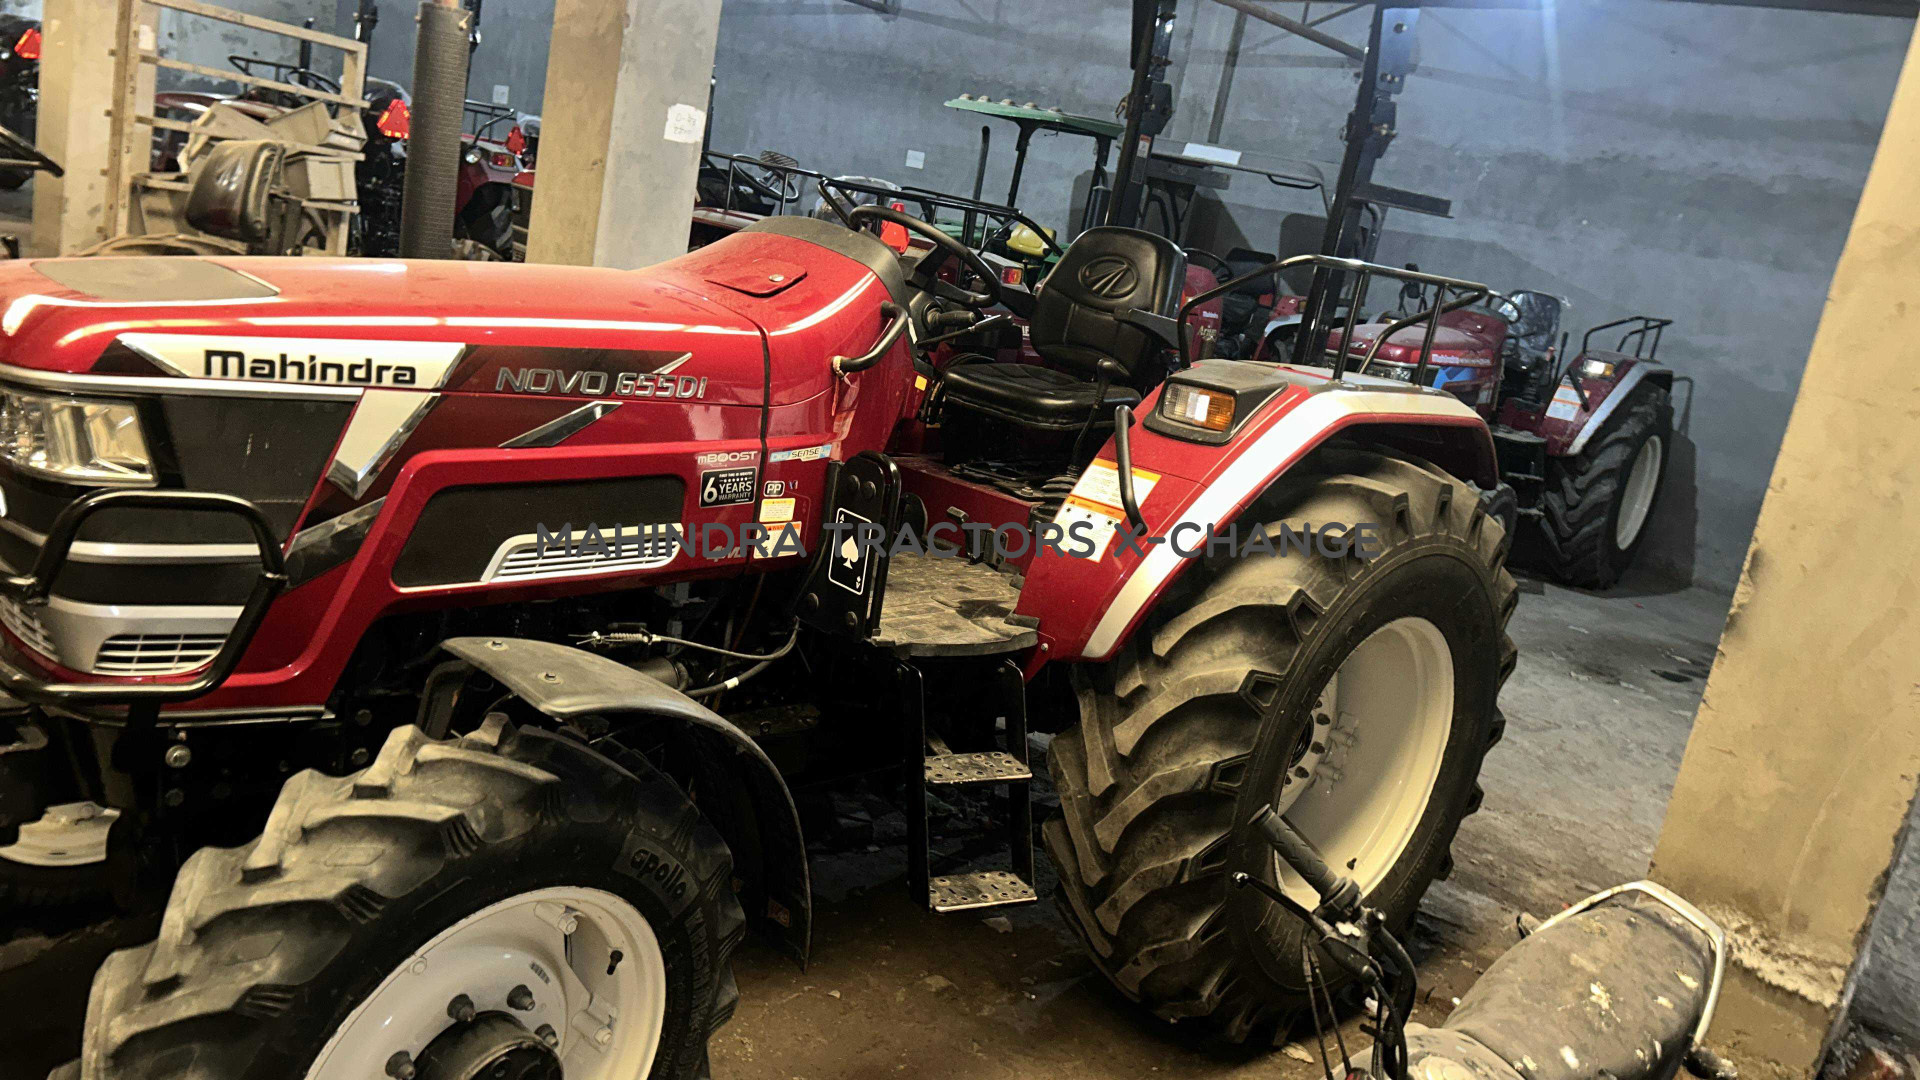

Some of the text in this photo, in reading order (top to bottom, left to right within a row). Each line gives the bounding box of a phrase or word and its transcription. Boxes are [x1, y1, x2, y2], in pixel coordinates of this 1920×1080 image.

[204, 349, 416, 385] Mahindra
[495, 367, 708, 399] NOVO 655DI
[703, 477, 718, 503] 6
